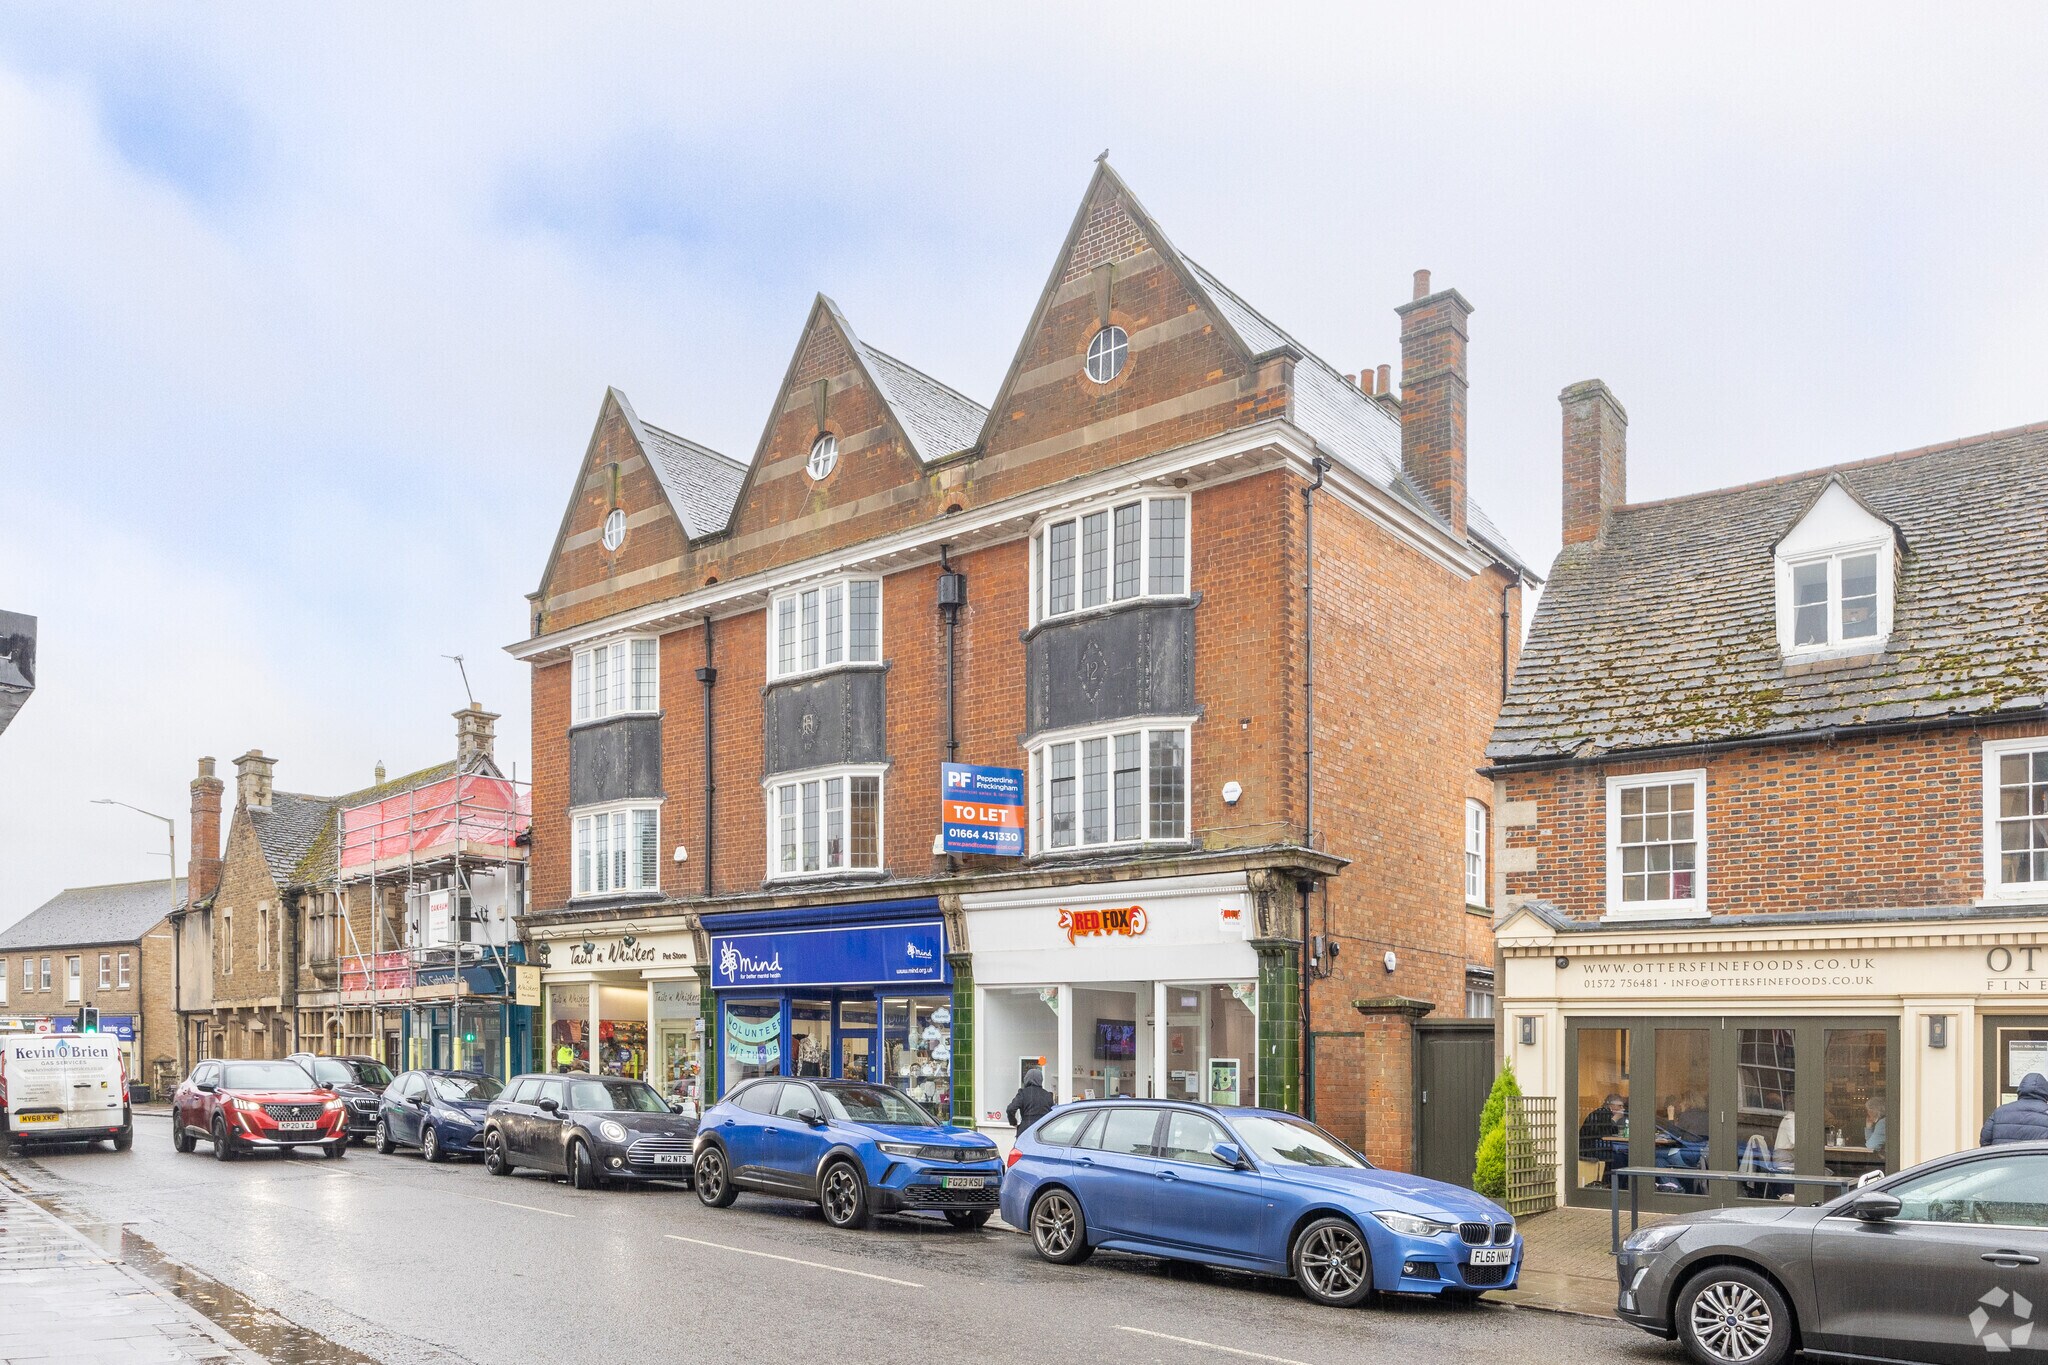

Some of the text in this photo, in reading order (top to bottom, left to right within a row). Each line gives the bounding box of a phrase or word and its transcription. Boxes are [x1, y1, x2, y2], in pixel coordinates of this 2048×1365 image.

[976, 774, 1014, 785] Pepperdine
[976, 782, 1018, 792] Freckingham
[953, 805, 1008, 823] TO LET
[949, 828, 1018, 842] 01664 431330
[1074, 910, 1129, 930] RED FOX
[608, 940, 656, 963] Whiskers
[662, 952, 671, 960] Pet
[672, 952, 687, 960] Store
[895, 967, 934, 975] www.mind.org.uk
[1583, 958, 1875, 973] WWW.OTTERSFINEFOODS.CO.UK
[1584, 976, 1874, 988] 01572 756481 INFO@OTTERSFINEFOODS.CO.UK
[675, 990, 699, 1002] Whiskers
[16, 1044, 109, 1059] Kevin O'Brien
[766, 1045, 778, 1056] US
[673, 1155, 687, 1163] NTS
[947, 1177, 983, 1187] FG23 KSU
[1474, 1251, 1509, 1263] FL66 NNH
